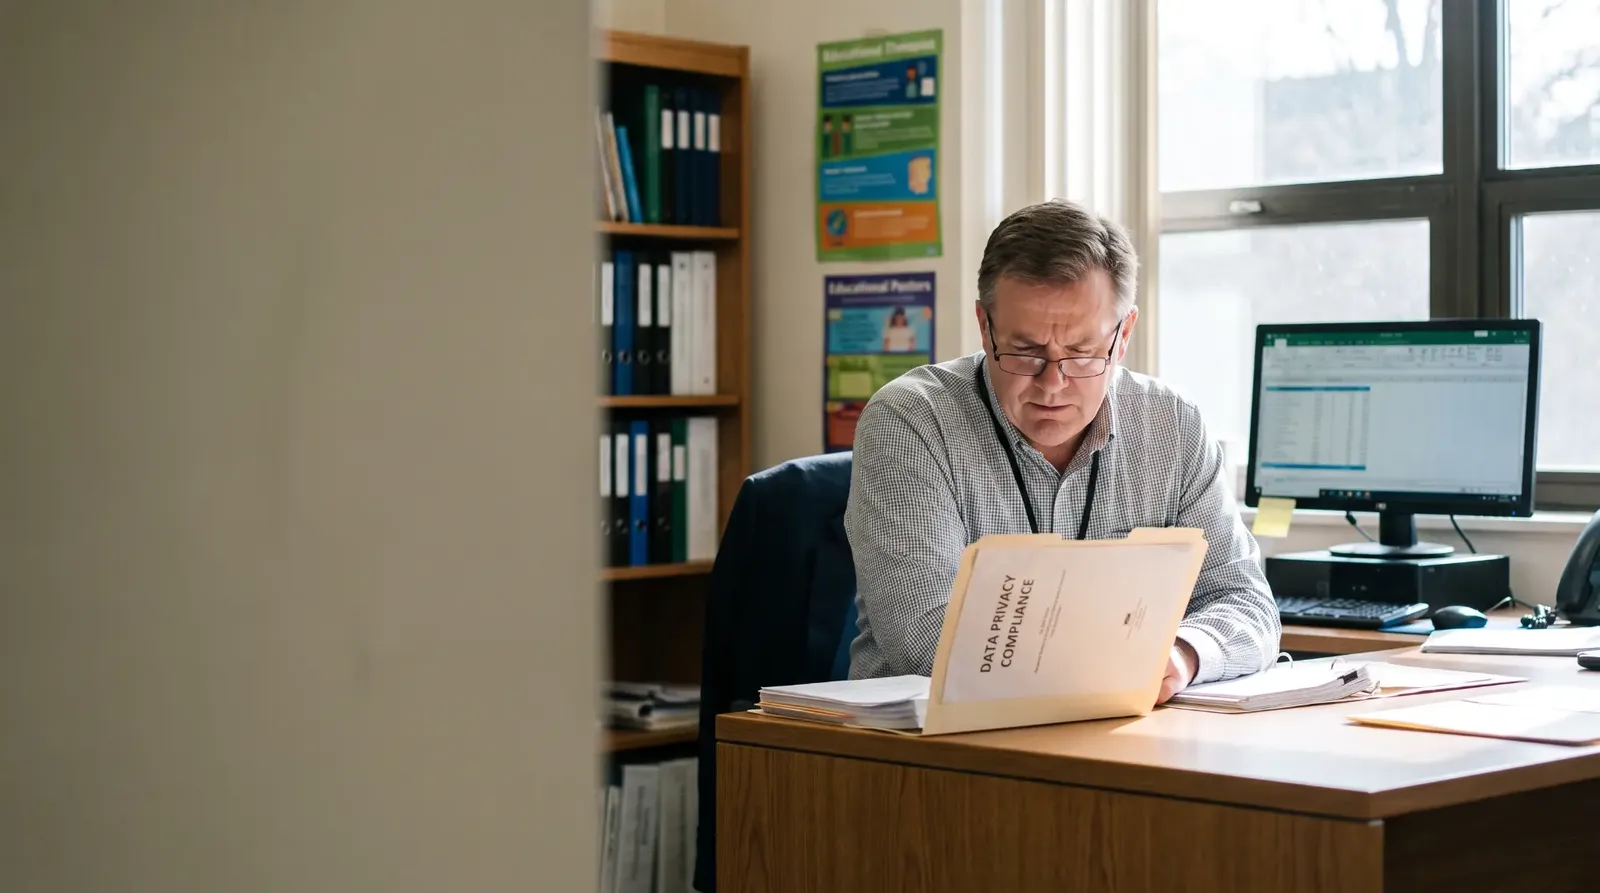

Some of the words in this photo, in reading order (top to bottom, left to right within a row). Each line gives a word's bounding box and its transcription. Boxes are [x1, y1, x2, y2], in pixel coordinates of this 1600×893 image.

[829, 280, 888, 295] Educational
[890, 279, 932, 293] Posters
[980, 635, 999, 673] DATA
[990, 575, 1016, 631] PRIVACY
[1001, 579, 1034, 668] COMPLIANCE
